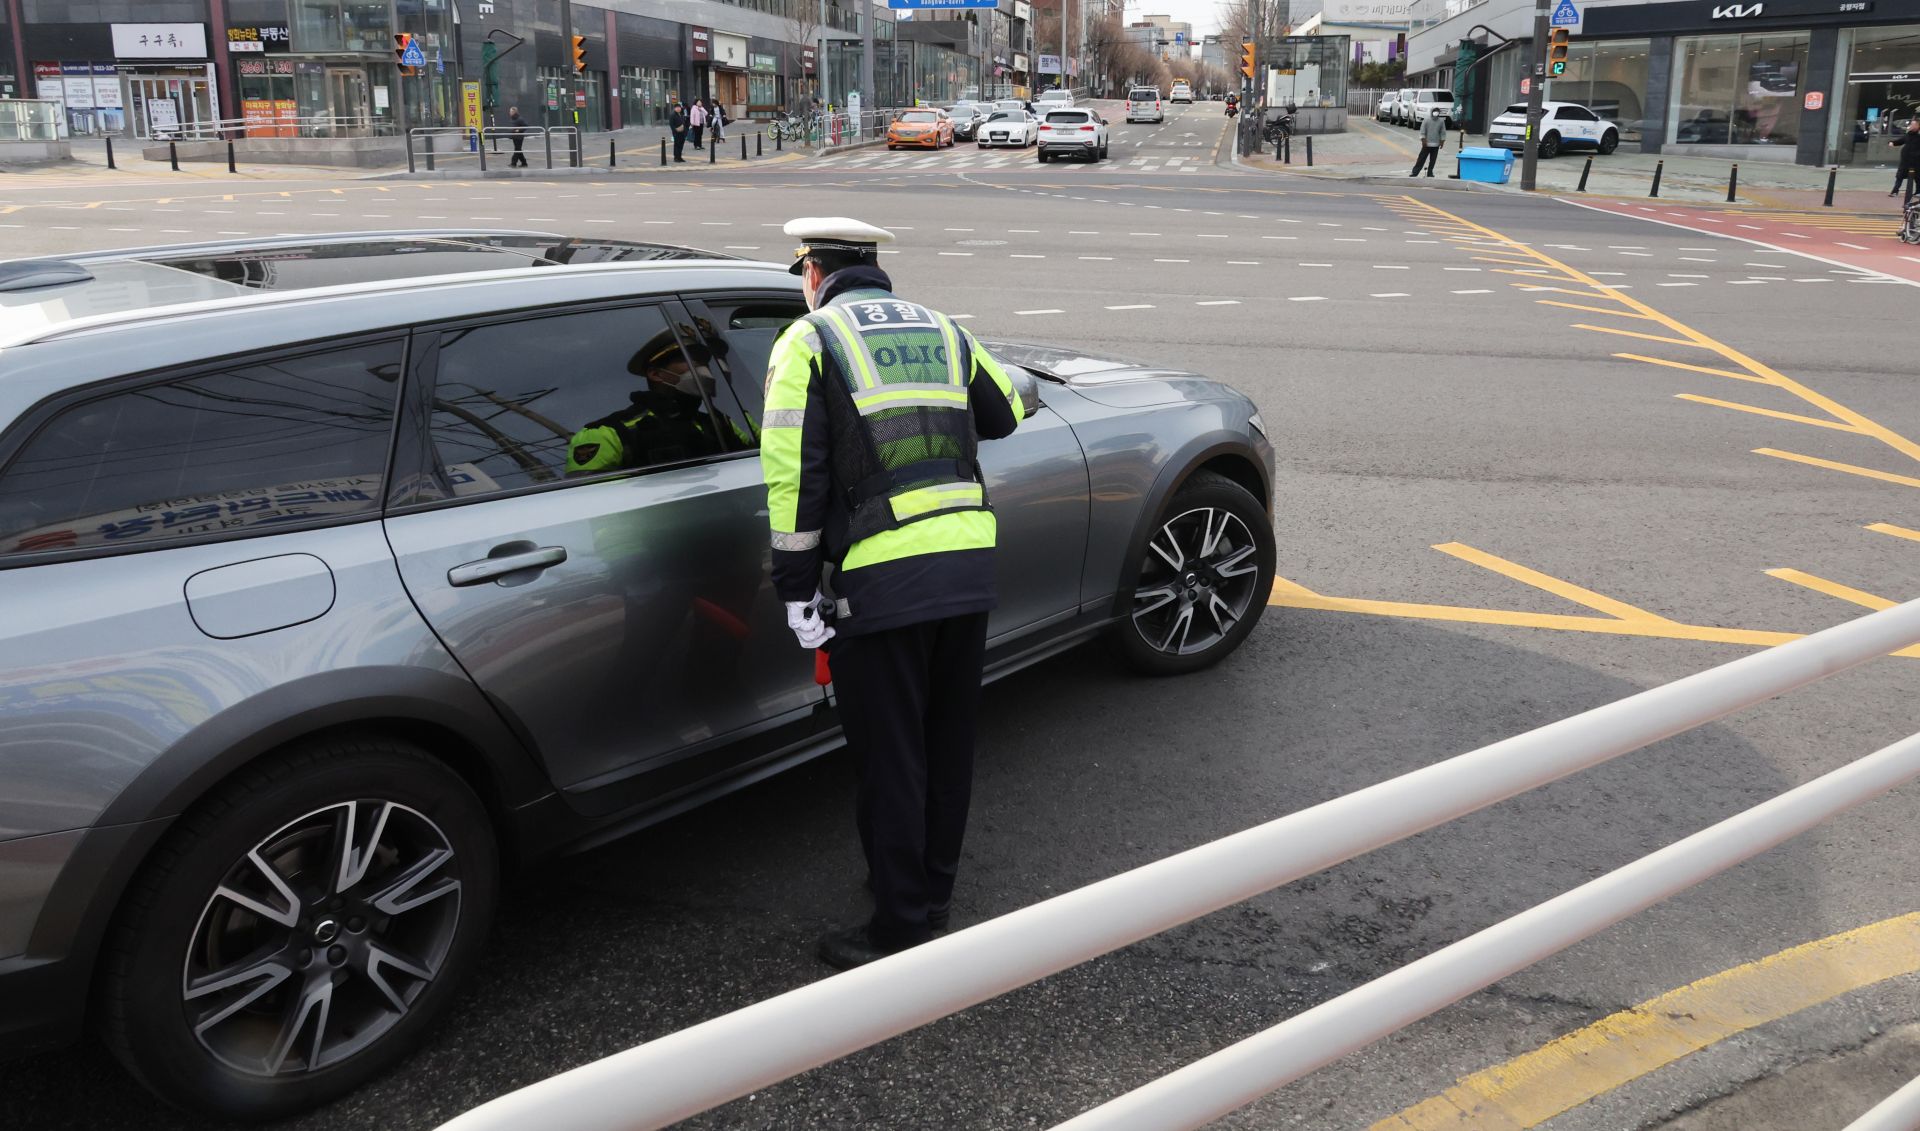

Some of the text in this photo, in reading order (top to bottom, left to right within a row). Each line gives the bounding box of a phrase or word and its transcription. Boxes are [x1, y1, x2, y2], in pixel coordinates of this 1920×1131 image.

[259, 27, 289, 41] 부동산
[860, 303, 921, 322] 경찰
[873, 344, 949, 368] OLIC
